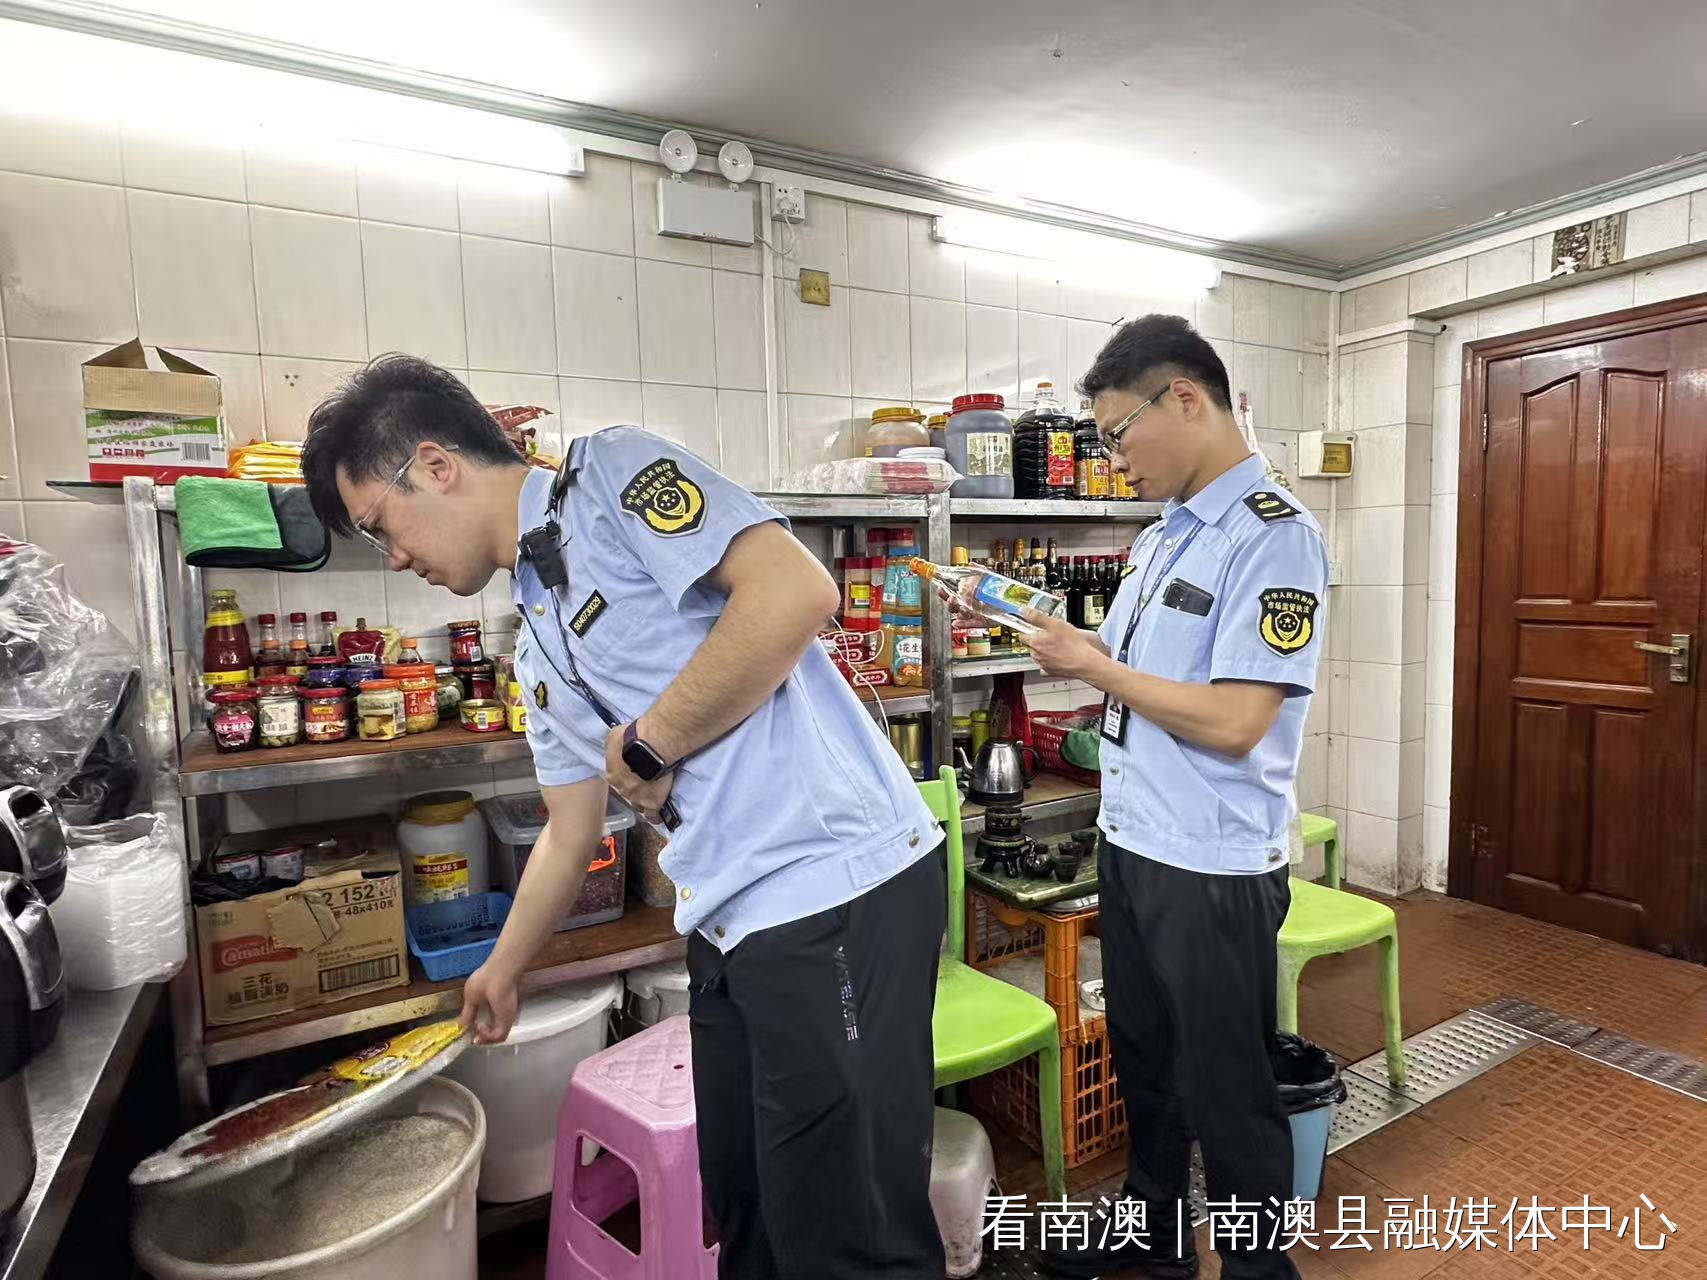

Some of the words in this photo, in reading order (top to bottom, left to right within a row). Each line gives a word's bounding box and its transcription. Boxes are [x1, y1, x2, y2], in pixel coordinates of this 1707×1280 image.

[626, 462, 672, 505] 中华人民共和国
[1263, 592, 1315, 606] 中华人民共和国
[352, 654, 375, 663] HEINZ
[340, 884, 375, 904] 152
[242, 972, 273, 989] 三花
